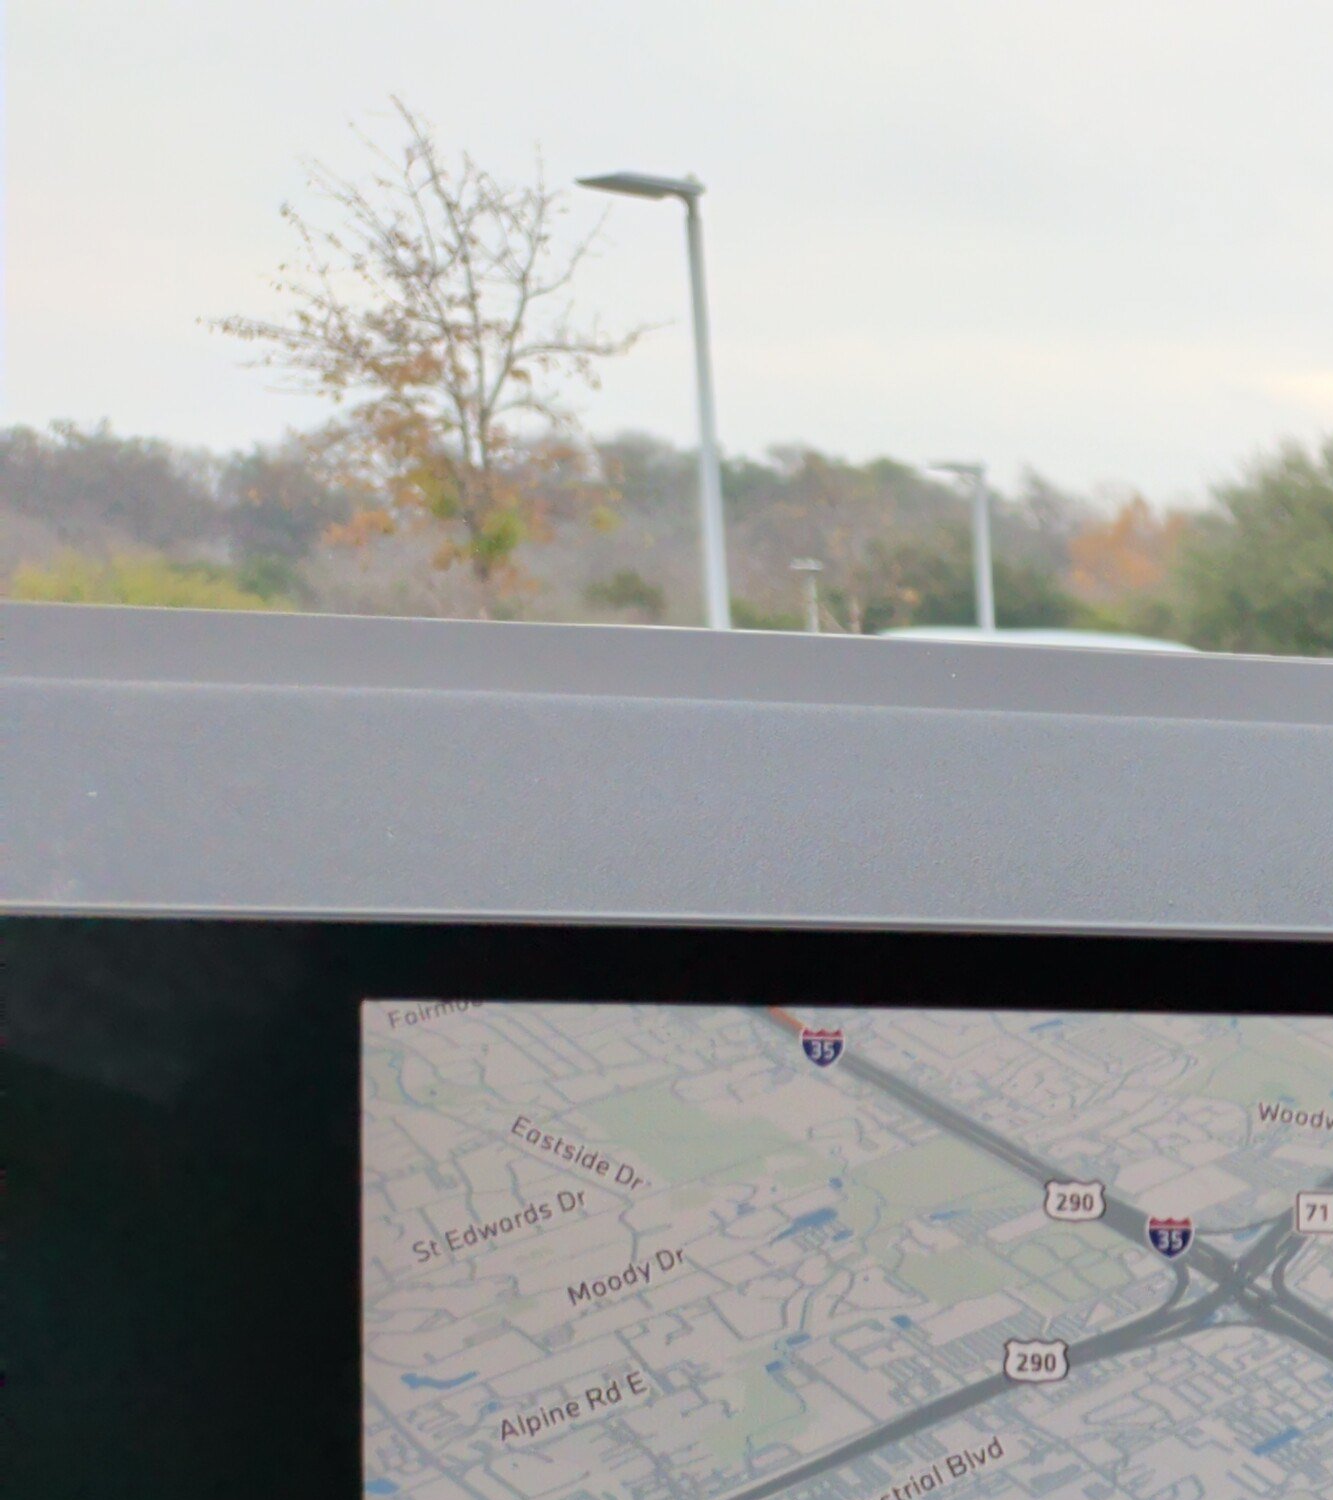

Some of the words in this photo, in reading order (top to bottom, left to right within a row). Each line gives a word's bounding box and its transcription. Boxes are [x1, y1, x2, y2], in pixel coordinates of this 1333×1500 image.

[810, 1041, 837, 1059] 35
[511, 1115, 610, 1177] Eastside
[615, 1163, 645, 1190] Dr
[1056, 1193, 1094, 1212] 290
[1305, 1203, 1329, 1221] 71
[412, 1239, 441, 1263] St
[444, 1203, 553, 1251] Edwards
[556, 1190, 587, 1212] Dr
[1157, 1230, 1183, 1249] 35
[567, 1262, 652, 1306] Moody
[655, 1247, 686, 1272] Dr
[1016, 1353, 1057, 1372] 290
[500, 1397, 582, 1442] Alpine
[585, 1382, 622, 1412] Rd
[627, 1370, 648, 1396] E
[945, 1436, 1005, 1478] Blvd
